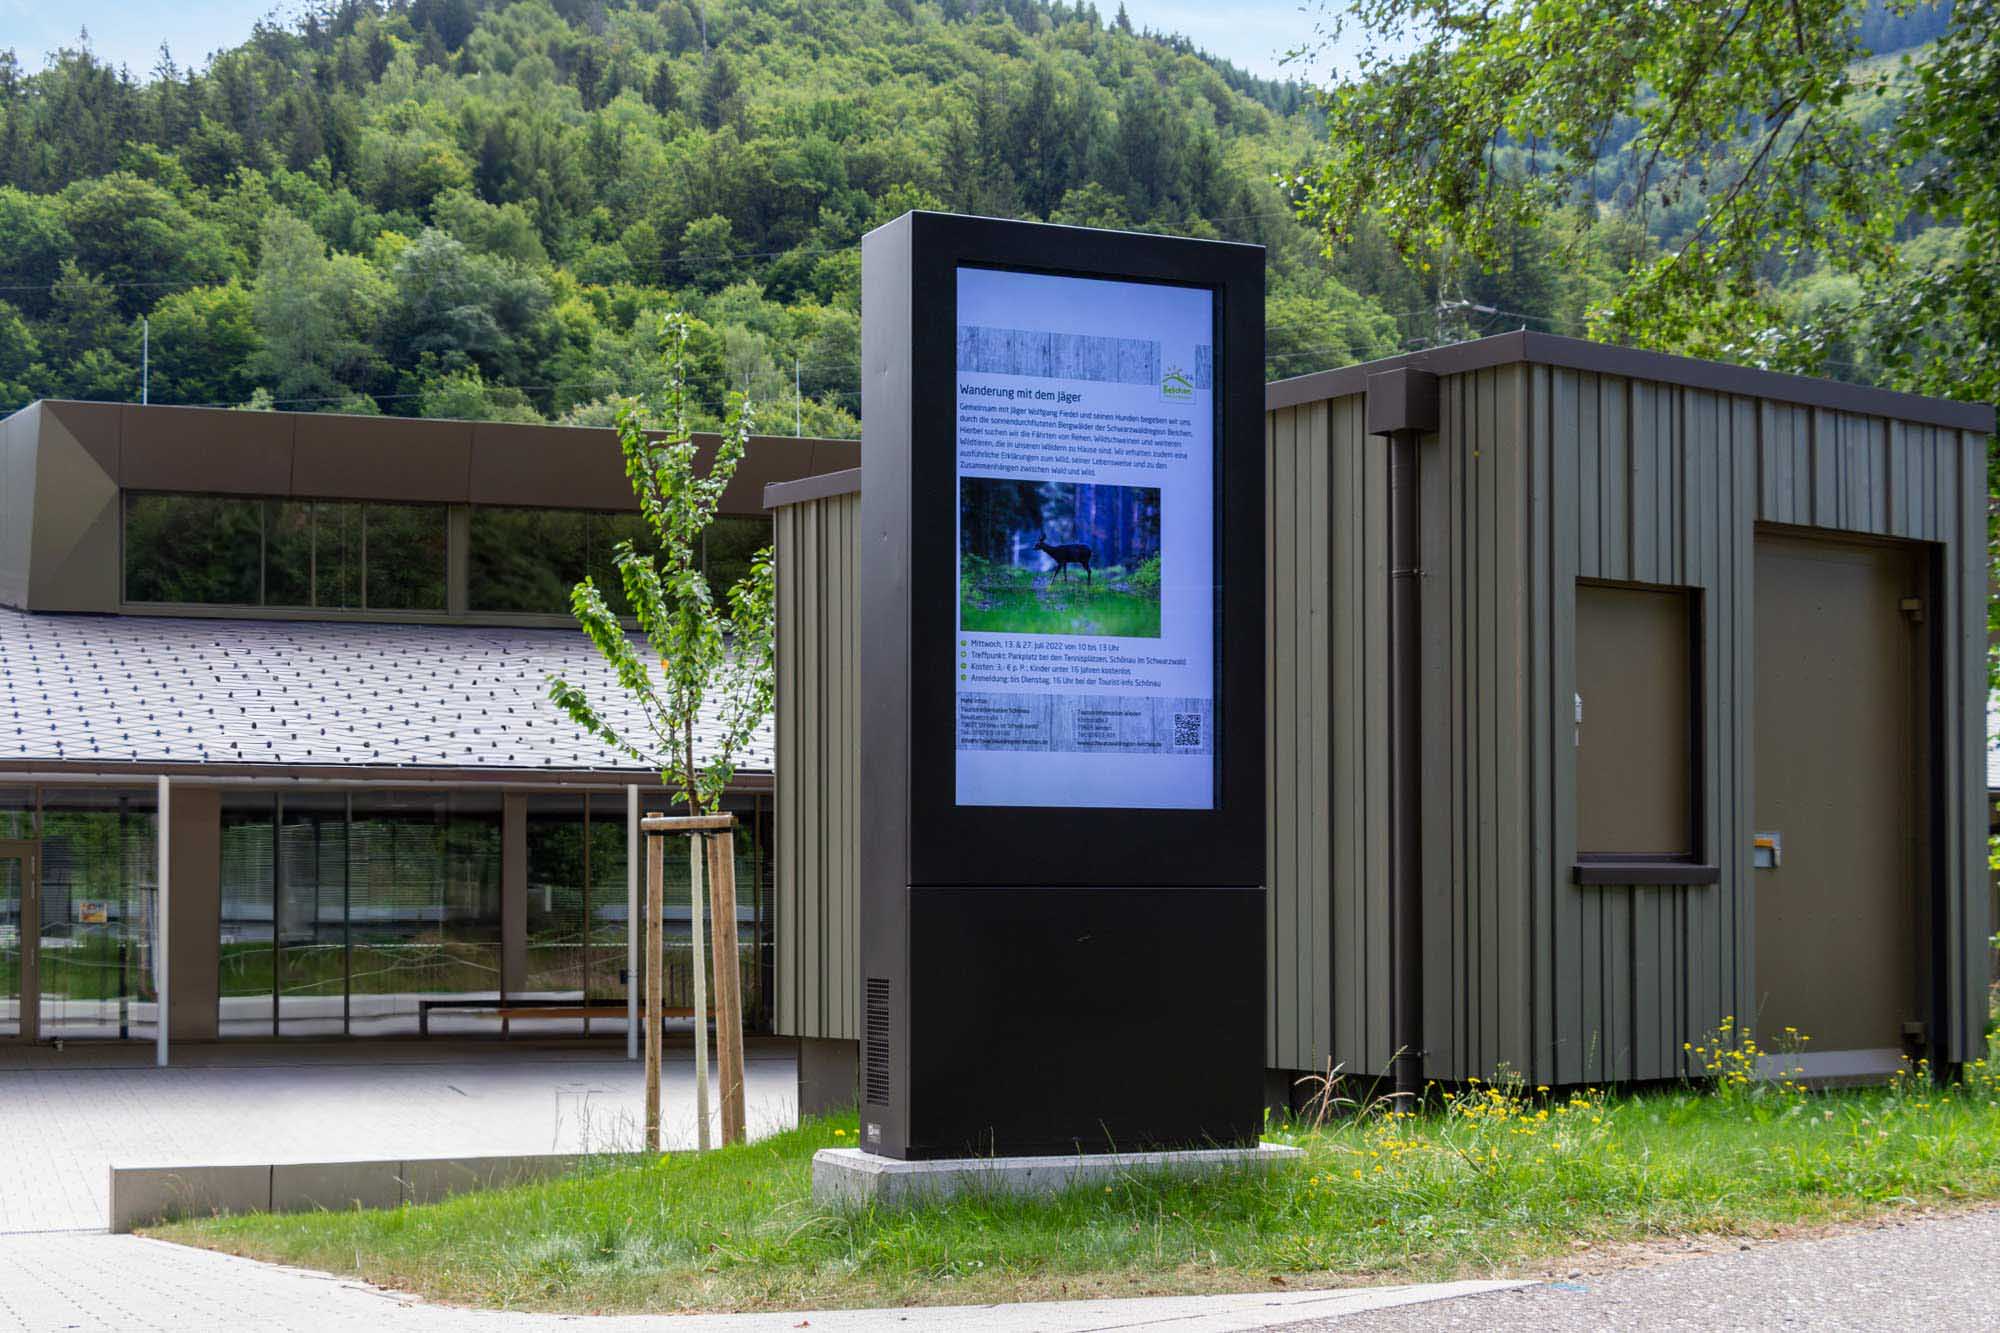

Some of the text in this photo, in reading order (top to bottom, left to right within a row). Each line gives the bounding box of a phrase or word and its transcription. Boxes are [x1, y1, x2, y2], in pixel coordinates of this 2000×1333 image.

[960, 384, 1081, 404] Wanderung mit dem Jäger
[960, 403, 997, 412] Gemeinsam
[1010, 406, 1026, 415] Jäger
[1028, 409, 1057, 417] Wolfgang
[1141, 416, 1167, 424] begeben
[960, 415, 977, 423] durch
[991, 418, 1056, 427] sonnendurchfluteten
[1058, 421, 1093, 430] Bergwälder
[1107, 424, 1166, 435] Schwarzwaldregion
[960, 438, 993, 447] Wildtieren,
[1032, 431, 1056, 439] Fährten
[1094, 435, 1139, 444] Wildschweinen
[960, 450, 999, 458] ausführliche
[1001, 452, 1039, 461] Erklärungen
[960, 461, 1018, 472] Zusammenhängen
[971, 640, 1002, 648] Mittwoch,
[1035, 642, 1044, 650] Juli
[972, 651, 1006, 659] Treffpunkt:
[1110, 656, 1135, 664] Schönau
[1147, 657, 1185, 665] Schwarzwald
[1080, 666, 1100, 674] Jahren
[1135, 679, 1161, 687] Schönau
